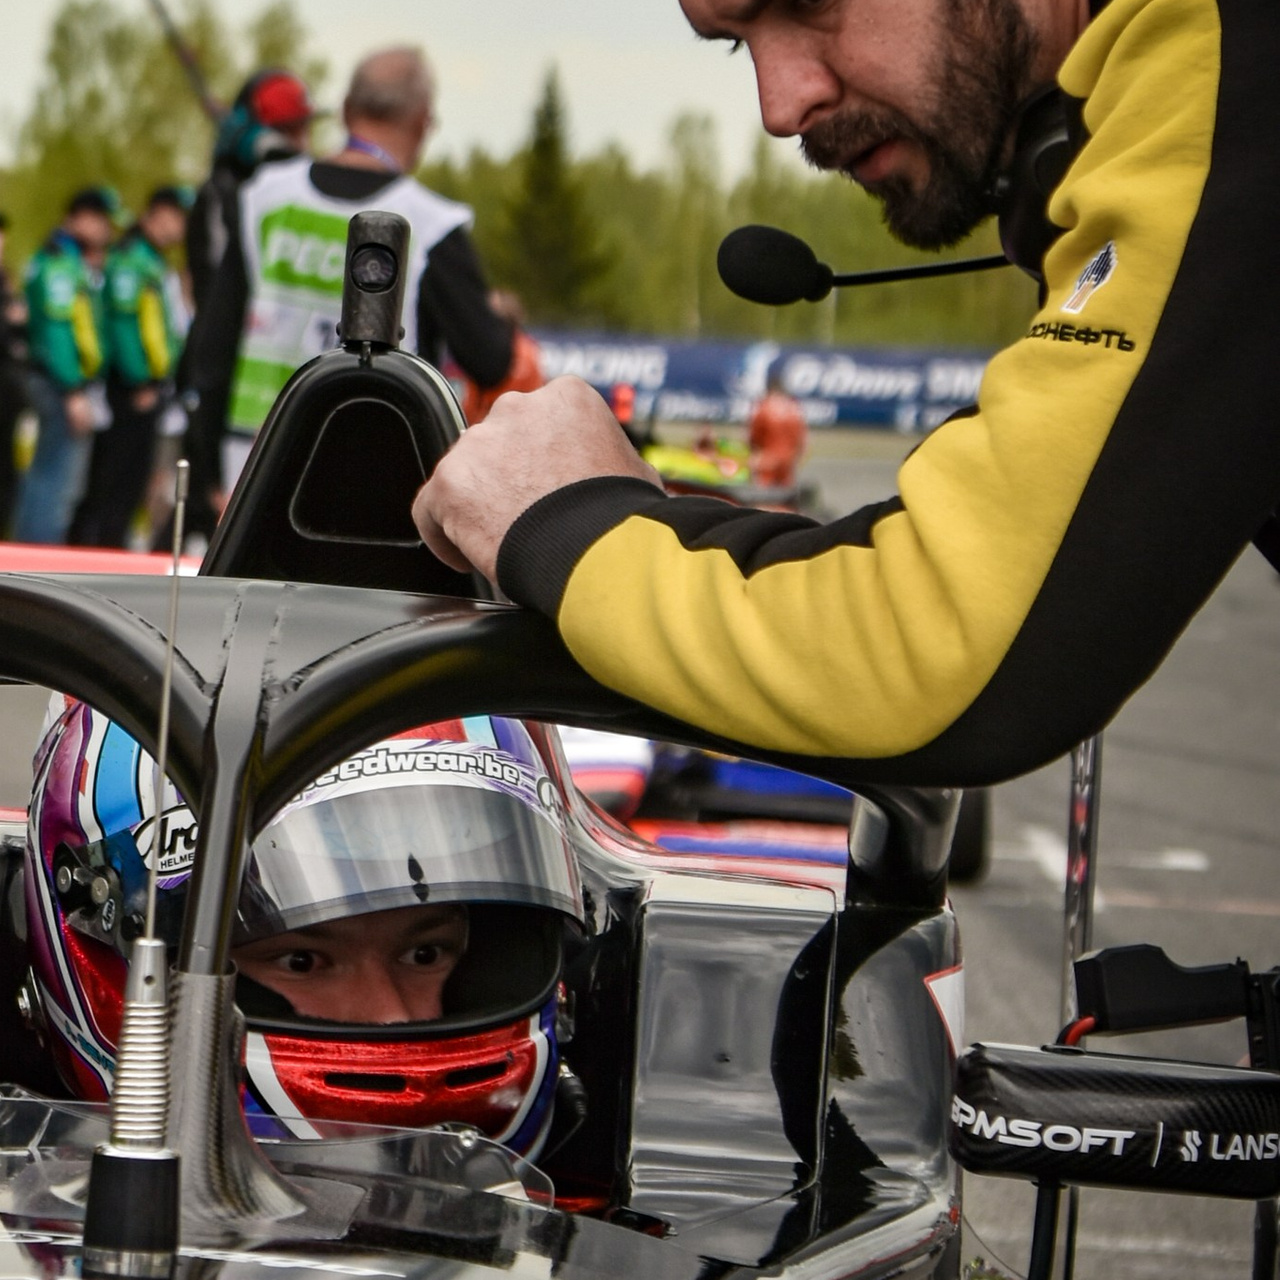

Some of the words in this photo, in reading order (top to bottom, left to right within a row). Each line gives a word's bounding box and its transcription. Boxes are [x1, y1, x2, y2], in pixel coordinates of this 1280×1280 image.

[292, 748, 521, 802] eedwear.be
[141, 816, 199, 859] Ara
[160, 852, 196, 870] HELME
